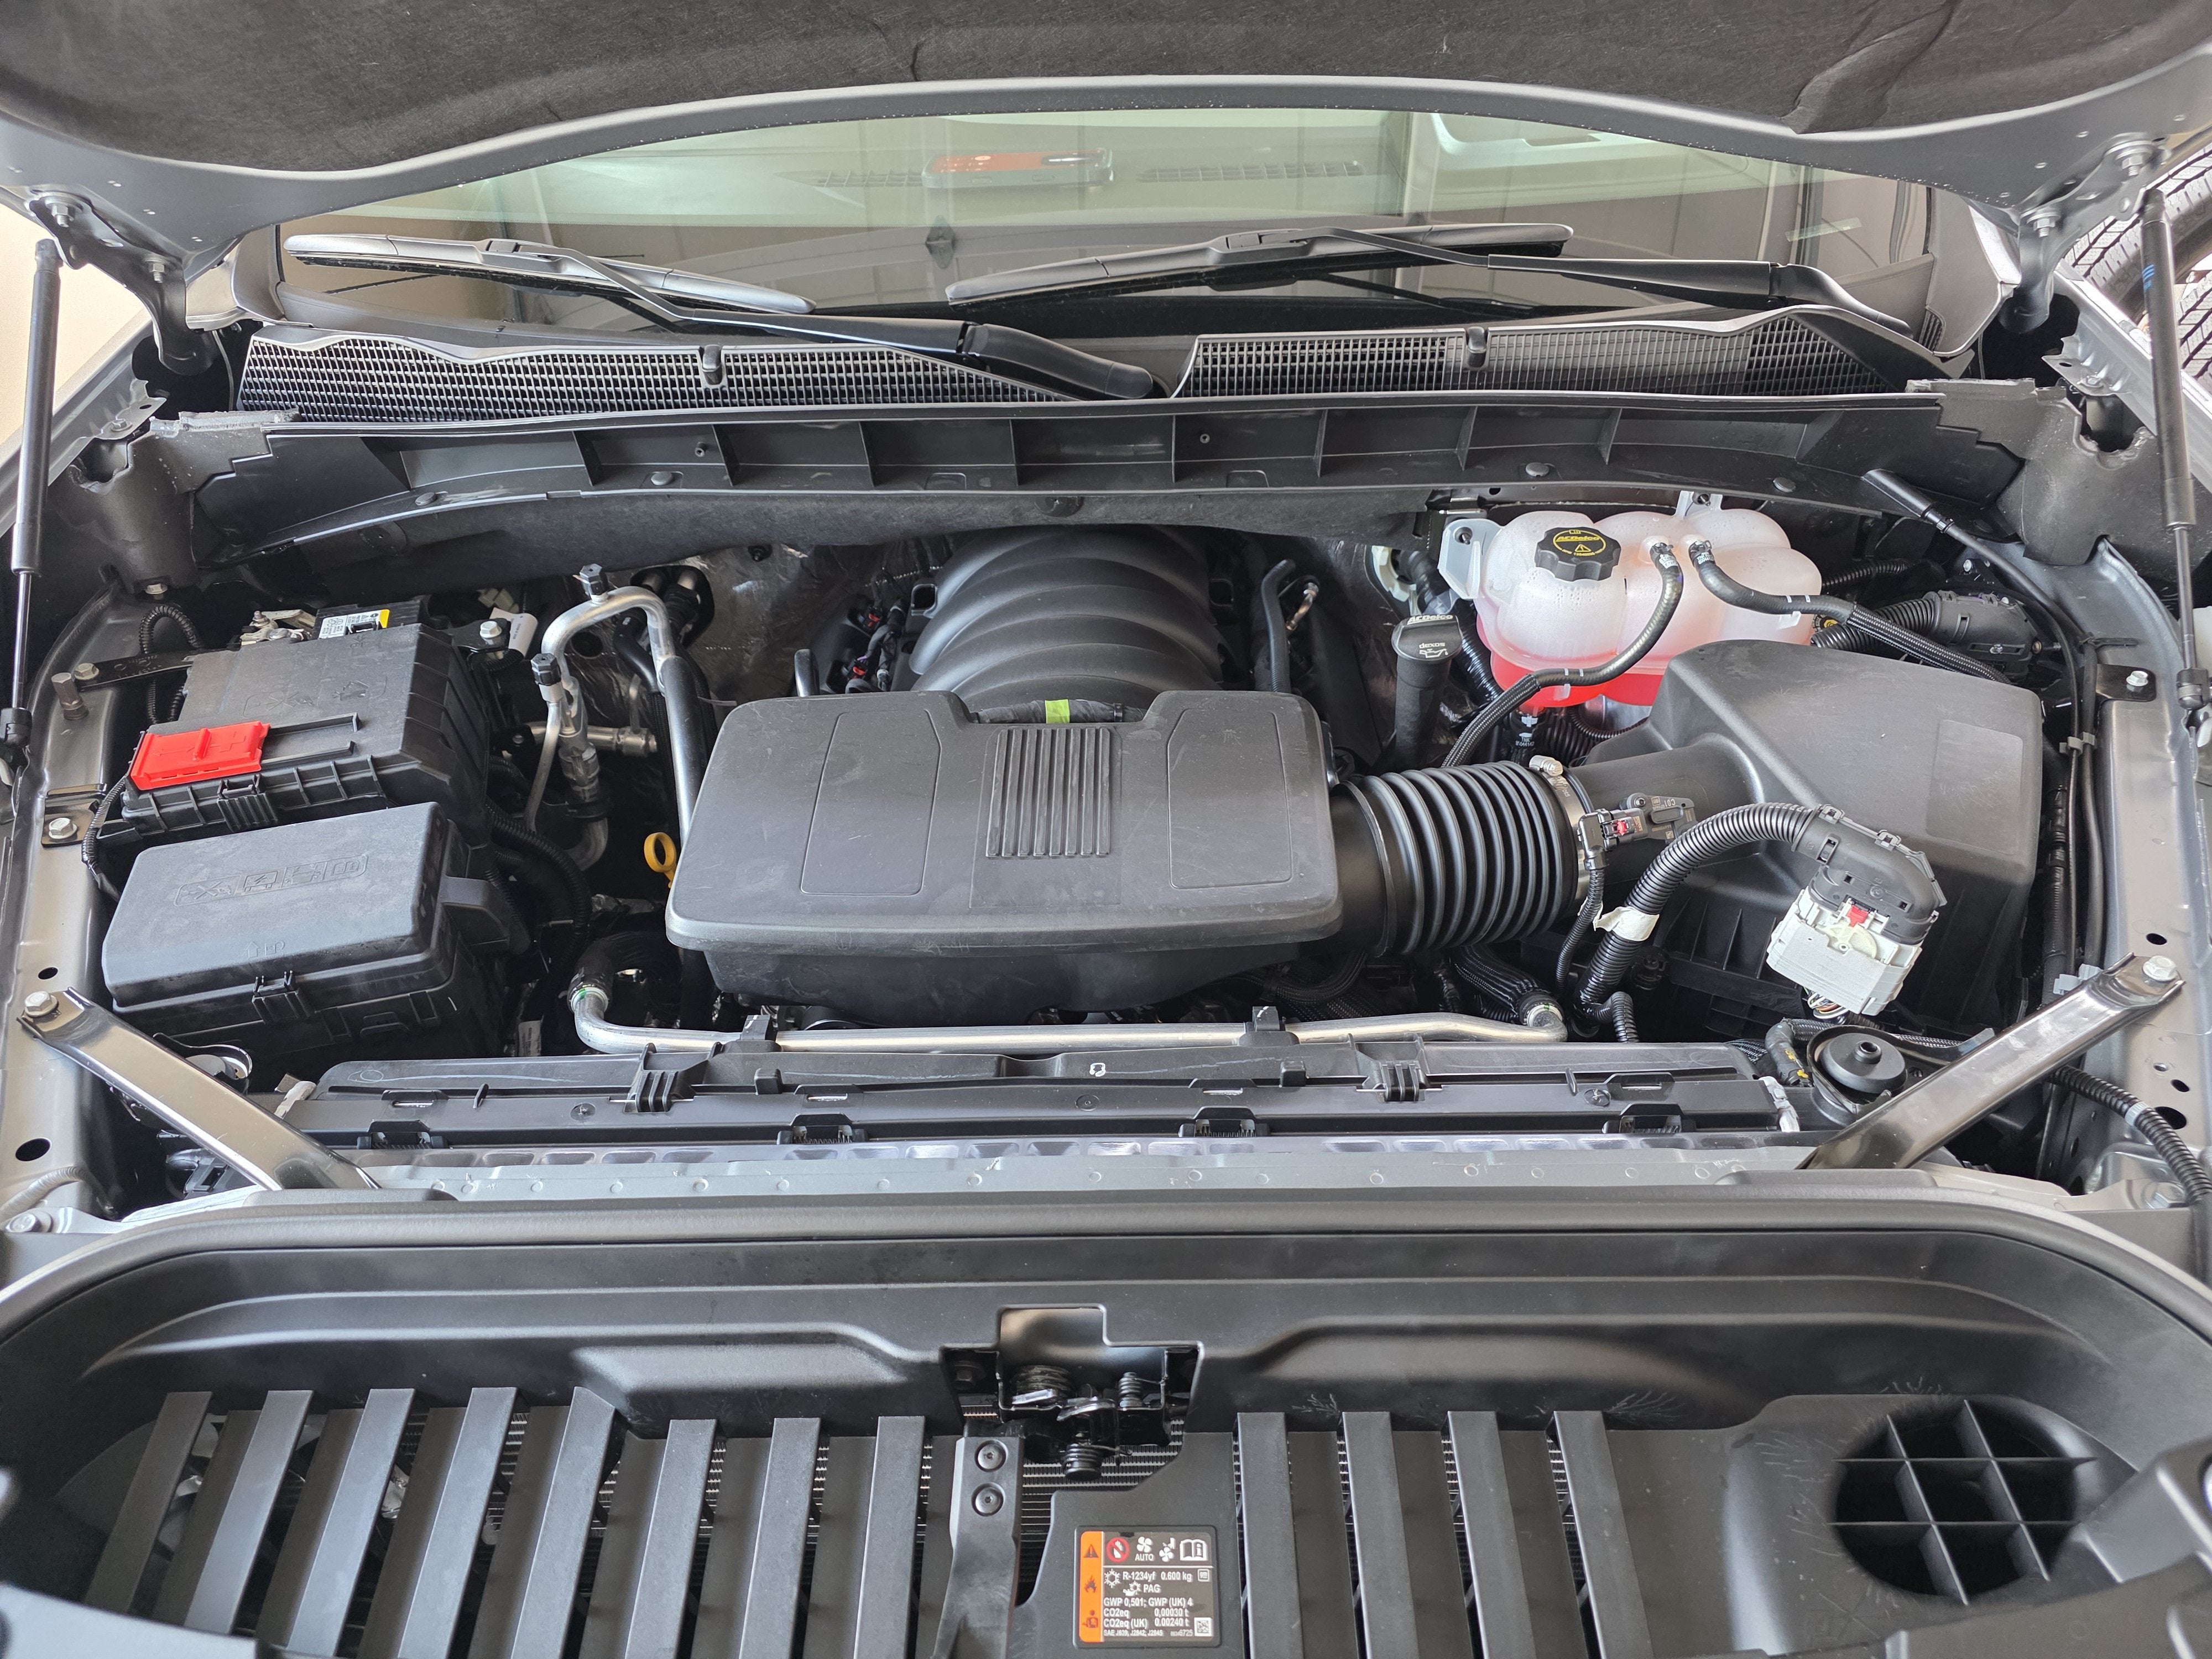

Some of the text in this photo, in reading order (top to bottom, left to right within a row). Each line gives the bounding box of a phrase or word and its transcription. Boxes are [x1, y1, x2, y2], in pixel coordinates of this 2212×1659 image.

[1407, 614, 1453, 625] ACDelco
[1123, 1571, 1193, 1582] R-1234yf 0.600 kg
[1143, 1584, 1161, 1593] PAG
[1104, 1597, 1123, 1606] GWP
[1148, 1597, 1167, 1606] GWP
[1168, 1597, 1186, 1608] (UK)
[1187, 1598, 1193, 1606] 4
[1104, 1608, 1130, 1618] CO2eq
[1185, 1608, 1189, 1617] t
[1104, 1618, 1148, 1629] CO2eq (UK)
[1185, 1618, 1190, 1626] t
